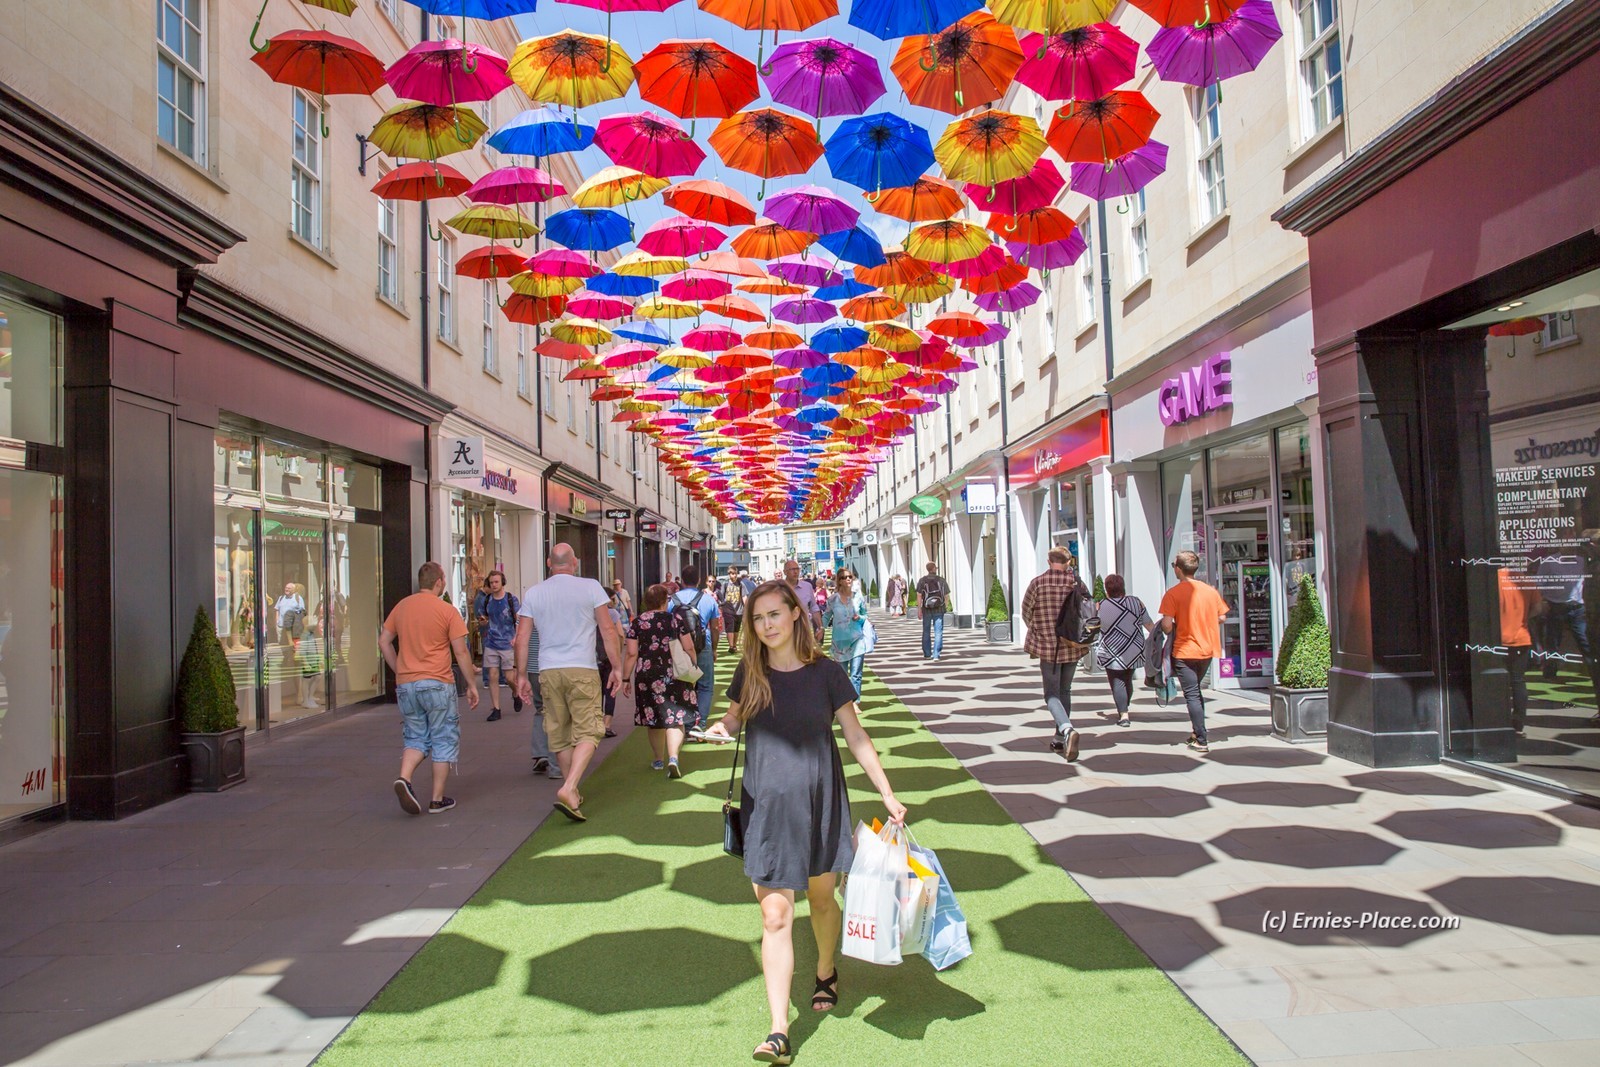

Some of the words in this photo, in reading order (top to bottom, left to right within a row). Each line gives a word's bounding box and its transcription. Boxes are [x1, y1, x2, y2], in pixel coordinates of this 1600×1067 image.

[1158, 352, 1232, 426] GAME
[452, 440, 474, 465] A
[1496, 470, 1538, 482] MAKEUP
[1542, 466, 1595, 480] SERVICES
[1497, 487, 1587, 502] COMPLIMENTARY
[1499, 517, 1575, 530] APPLICATIONS
[1500, 531, 1507, 540] &
[1511, 528, 1557, 540] LESSONS
[22, 768, 46, 796] H&M
[847, 920, 876, 940] SALE
